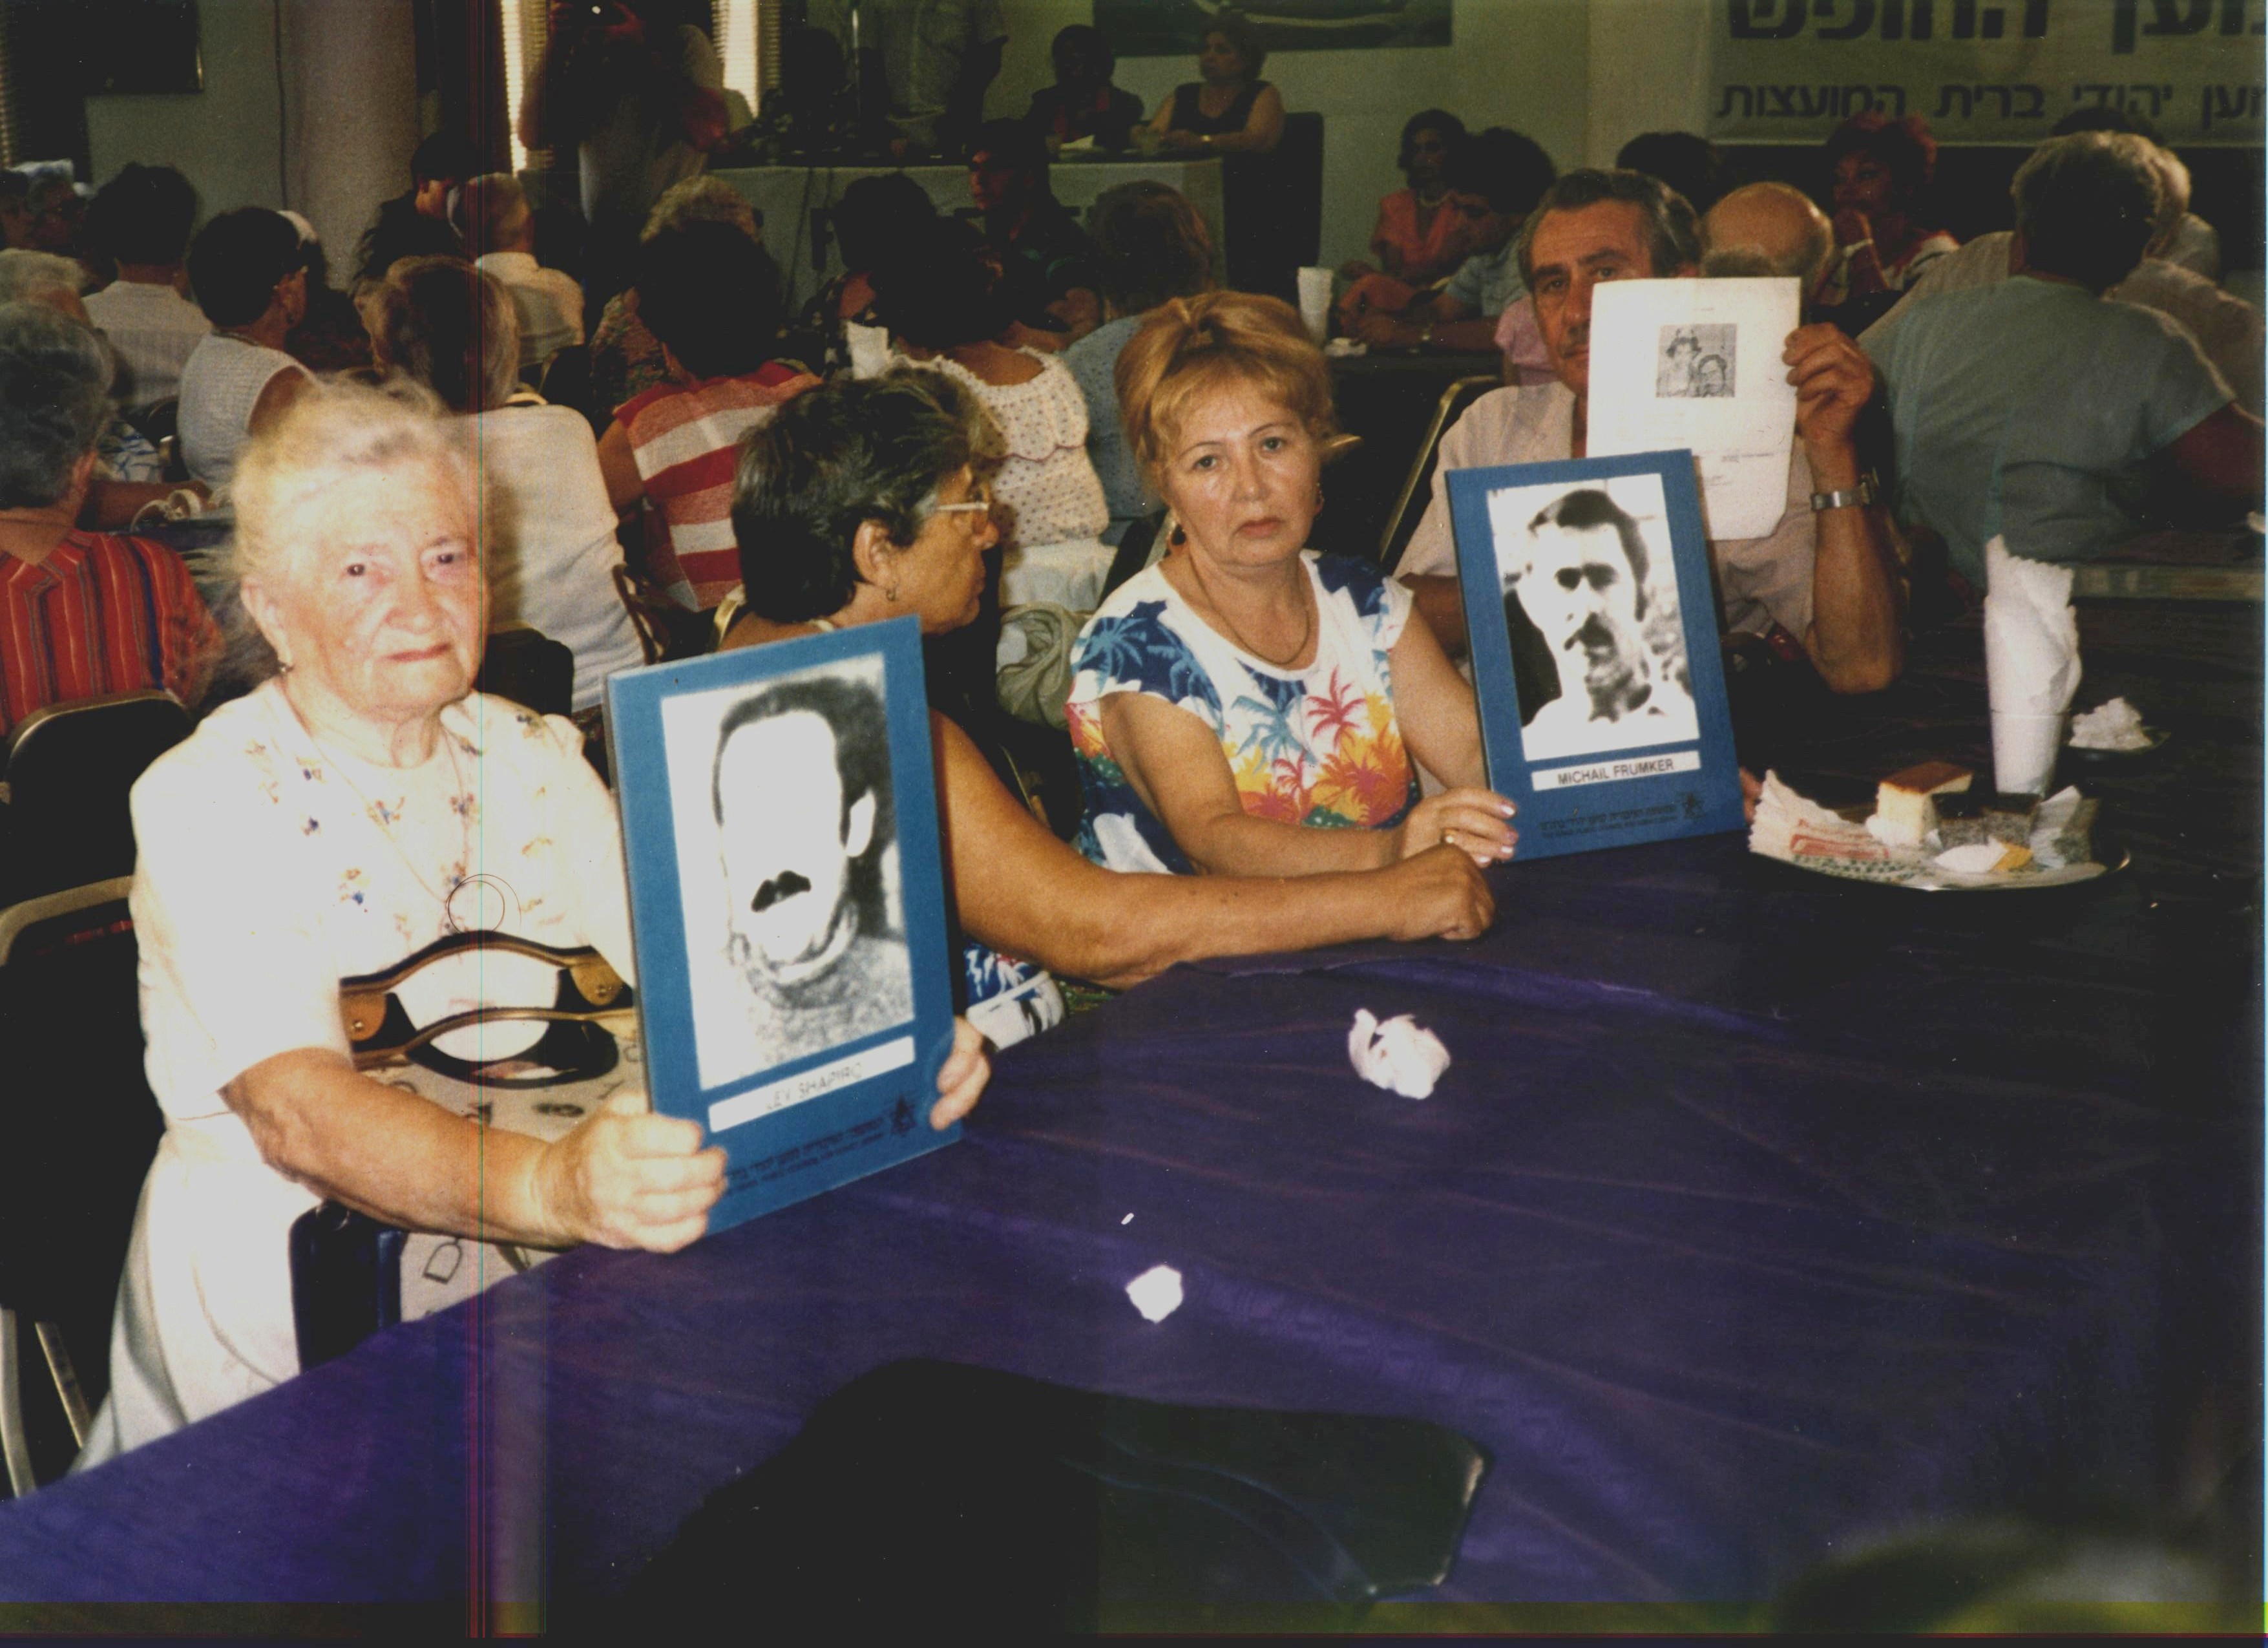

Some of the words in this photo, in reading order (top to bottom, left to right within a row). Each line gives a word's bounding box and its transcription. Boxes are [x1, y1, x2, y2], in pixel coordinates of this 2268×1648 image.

[1716, 85, 1906, 118] המועצות
[1933, 84, 2046, 118] ברית
[1557, 766, 1610, 785] MICHAIL
[1613, 758, 1674, 777] FRUMKER
